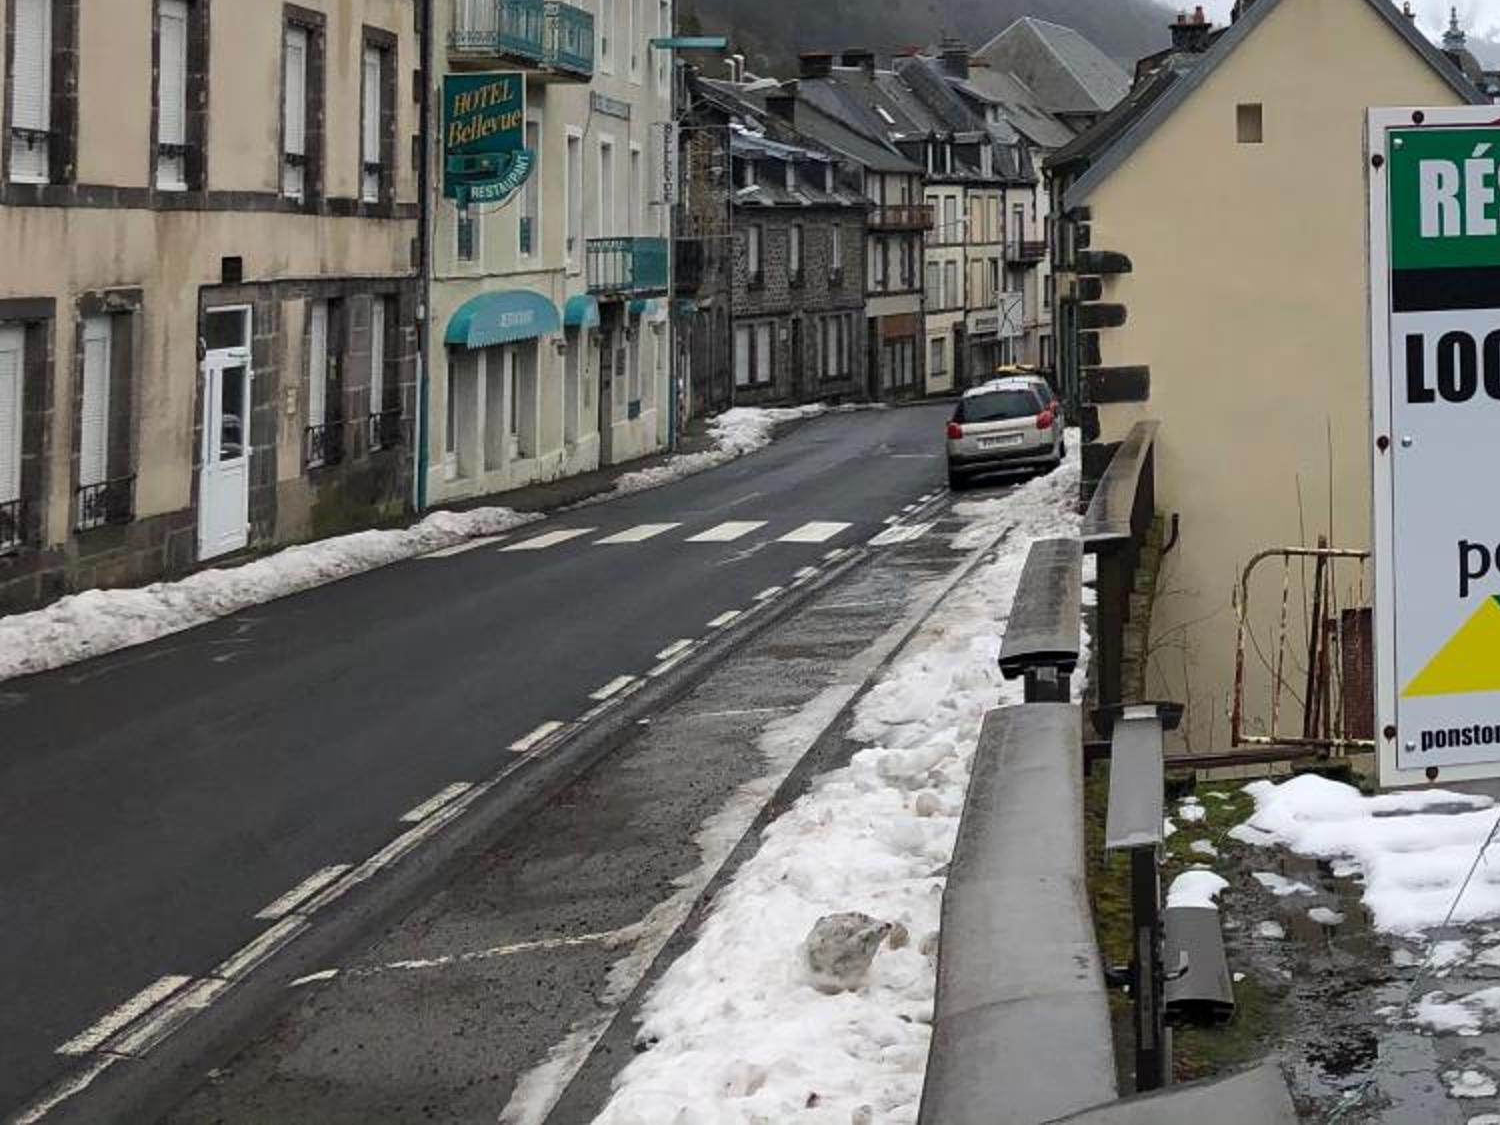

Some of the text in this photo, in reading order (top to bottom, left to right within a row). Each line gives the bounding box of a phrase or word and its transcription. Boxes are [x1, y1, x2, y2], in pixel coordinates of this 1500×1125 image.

[452, 78, 514, 116] HOTEL
[447, 109, 524, 148] Bellevue
[470, 154, 530, 199] RESTAURANT
